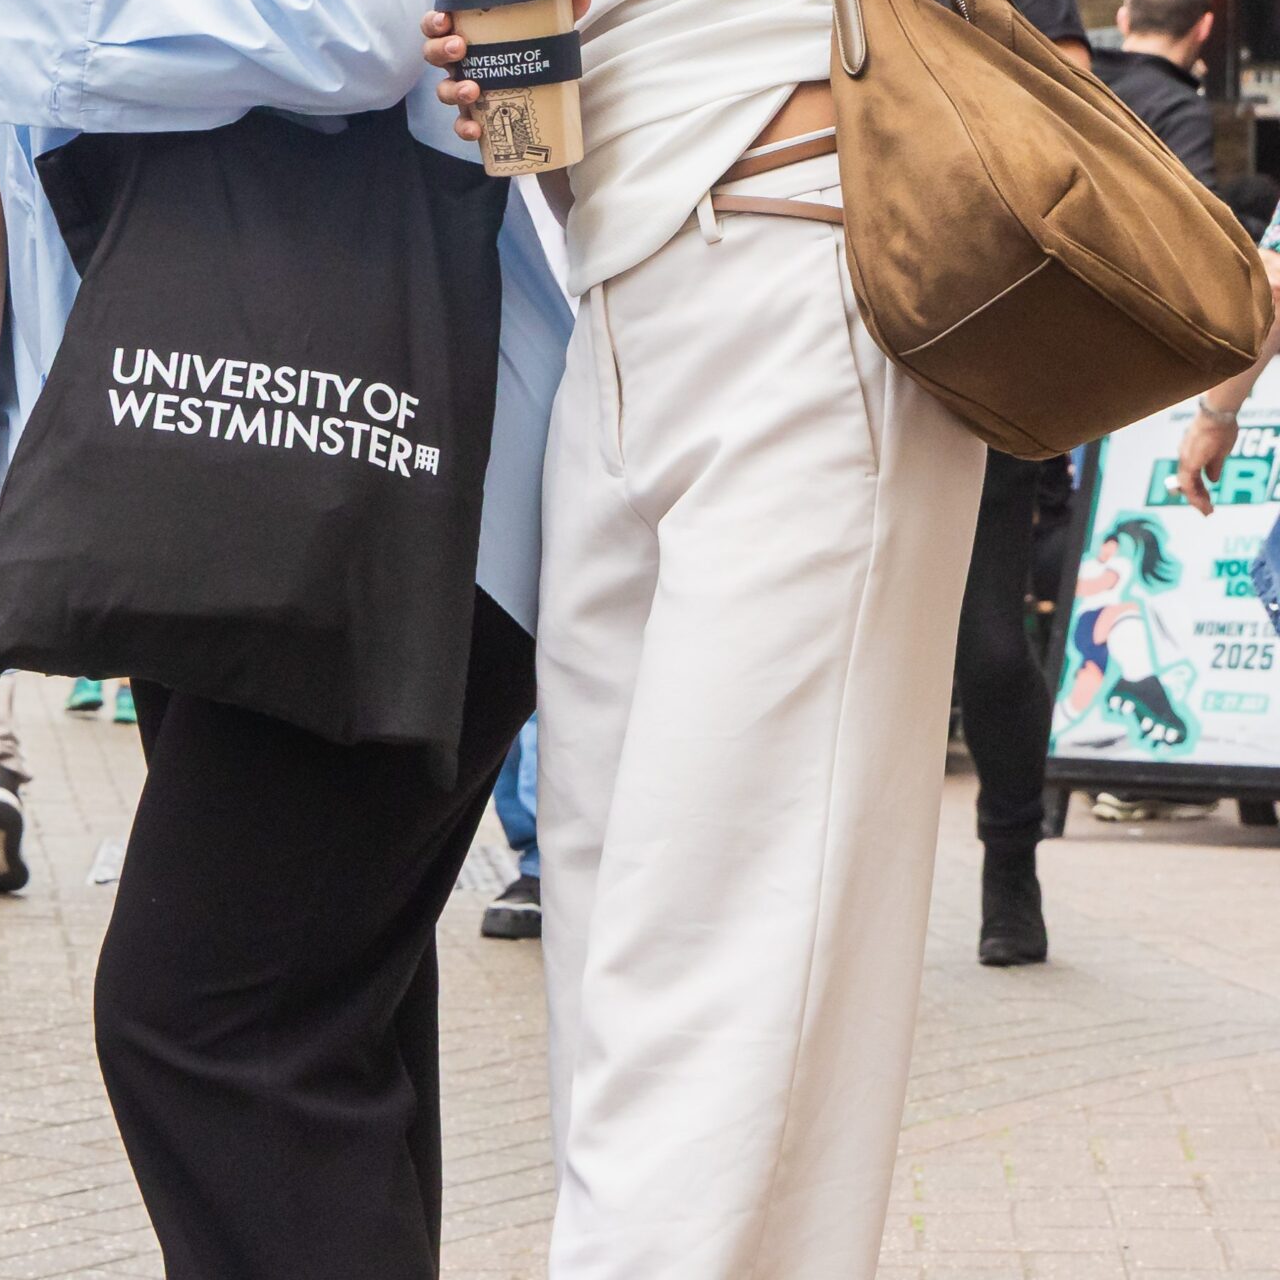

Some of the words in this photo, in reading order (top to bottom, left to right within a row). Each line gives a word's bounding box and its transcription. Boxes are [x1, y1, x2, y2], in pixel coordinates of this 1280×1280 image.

[461, 52, 522, 68] UNIVERSITY
[524, 49, 541, 62] OF
[462, 61, 543, 79] WESTMINSTER
[112, 347, 362, 413] UNIVERSITY
[363, 382, 419, 429] OF
[108, 388, 414, 478] WESTMINSTER
[1211, 643, 1275, 670] 2025
